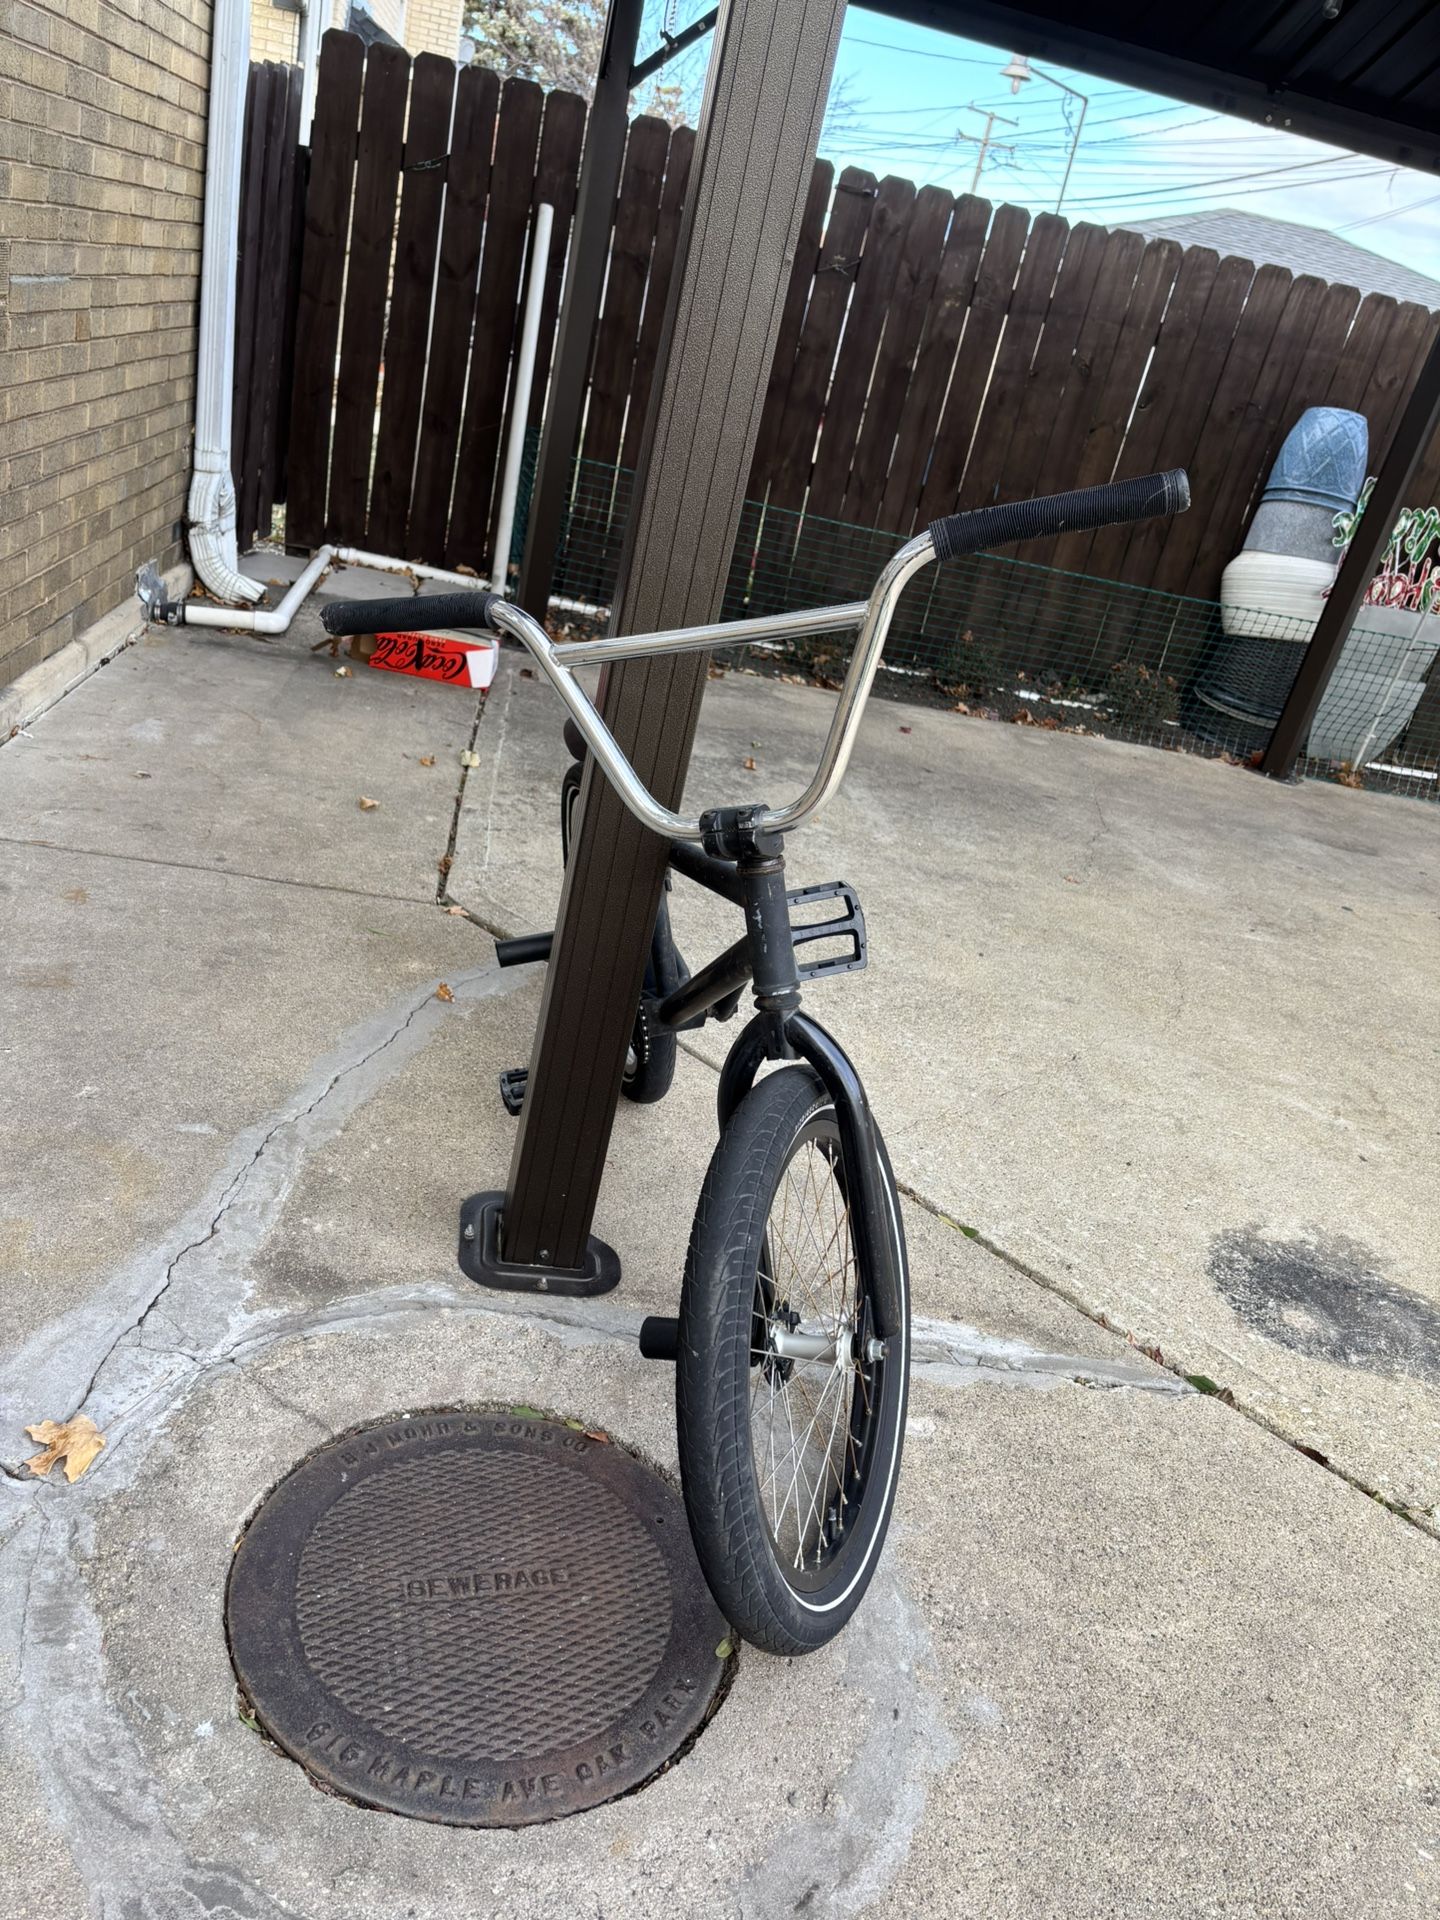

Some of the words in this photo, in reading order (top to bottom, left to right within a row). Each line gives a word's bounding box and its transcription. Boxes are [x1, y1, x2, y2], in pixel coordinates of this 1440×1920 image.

[406, 1567, 571, 1600] SEWERAGE
[366, 1755, 482, 1801] MAPLE
[501, 1772, 563, 1804] AVE
[575, 1743, 631, 1784] OAK
[639, 1676, 699, 1740] PARK
